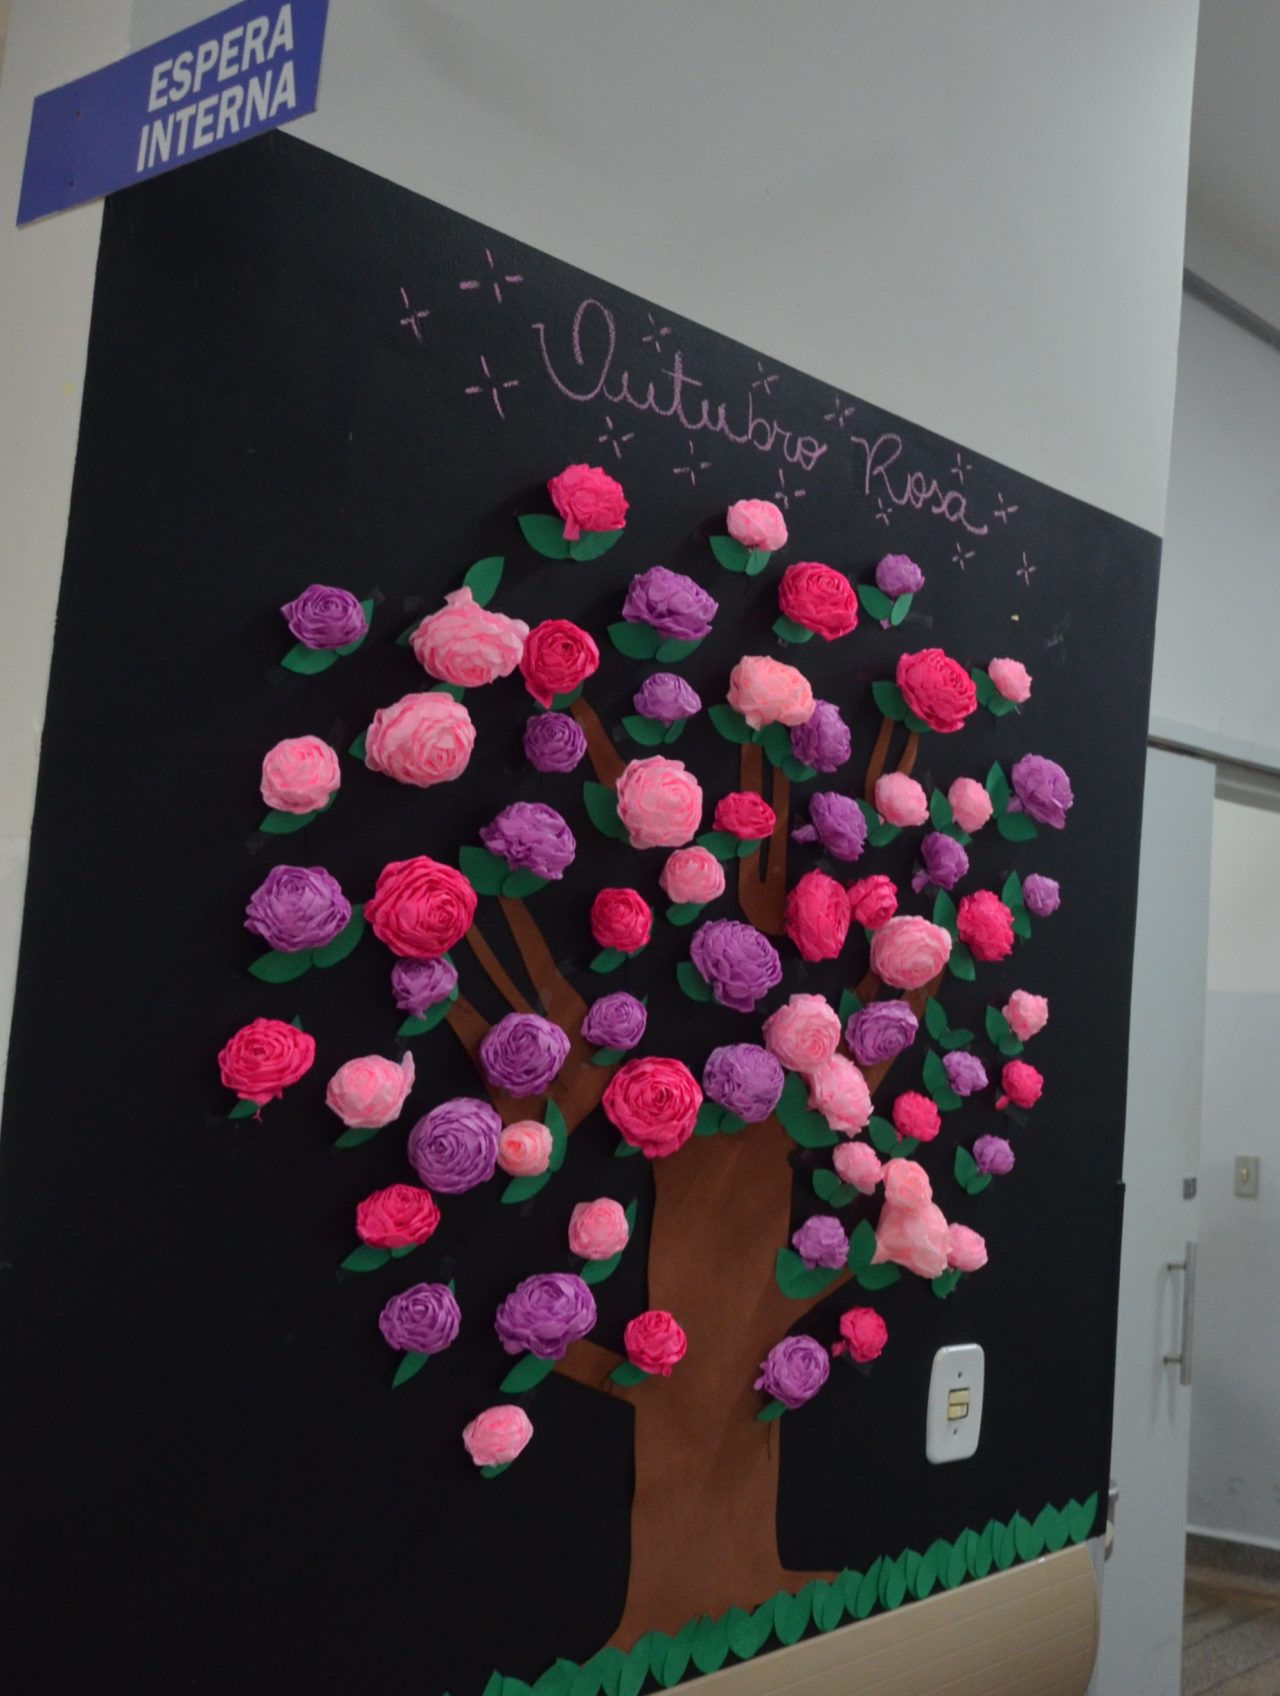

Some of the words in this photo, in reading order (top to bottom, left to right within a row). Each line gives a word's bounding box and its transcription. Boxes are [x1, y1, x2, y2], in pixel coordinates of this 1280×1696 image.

[147, 3, 294, 112] ESPERA
[136, 60, 296, 173] INTERNA
[532, 299, 827, 470] Outubro
[851, 433, 988, 535] Rosa
